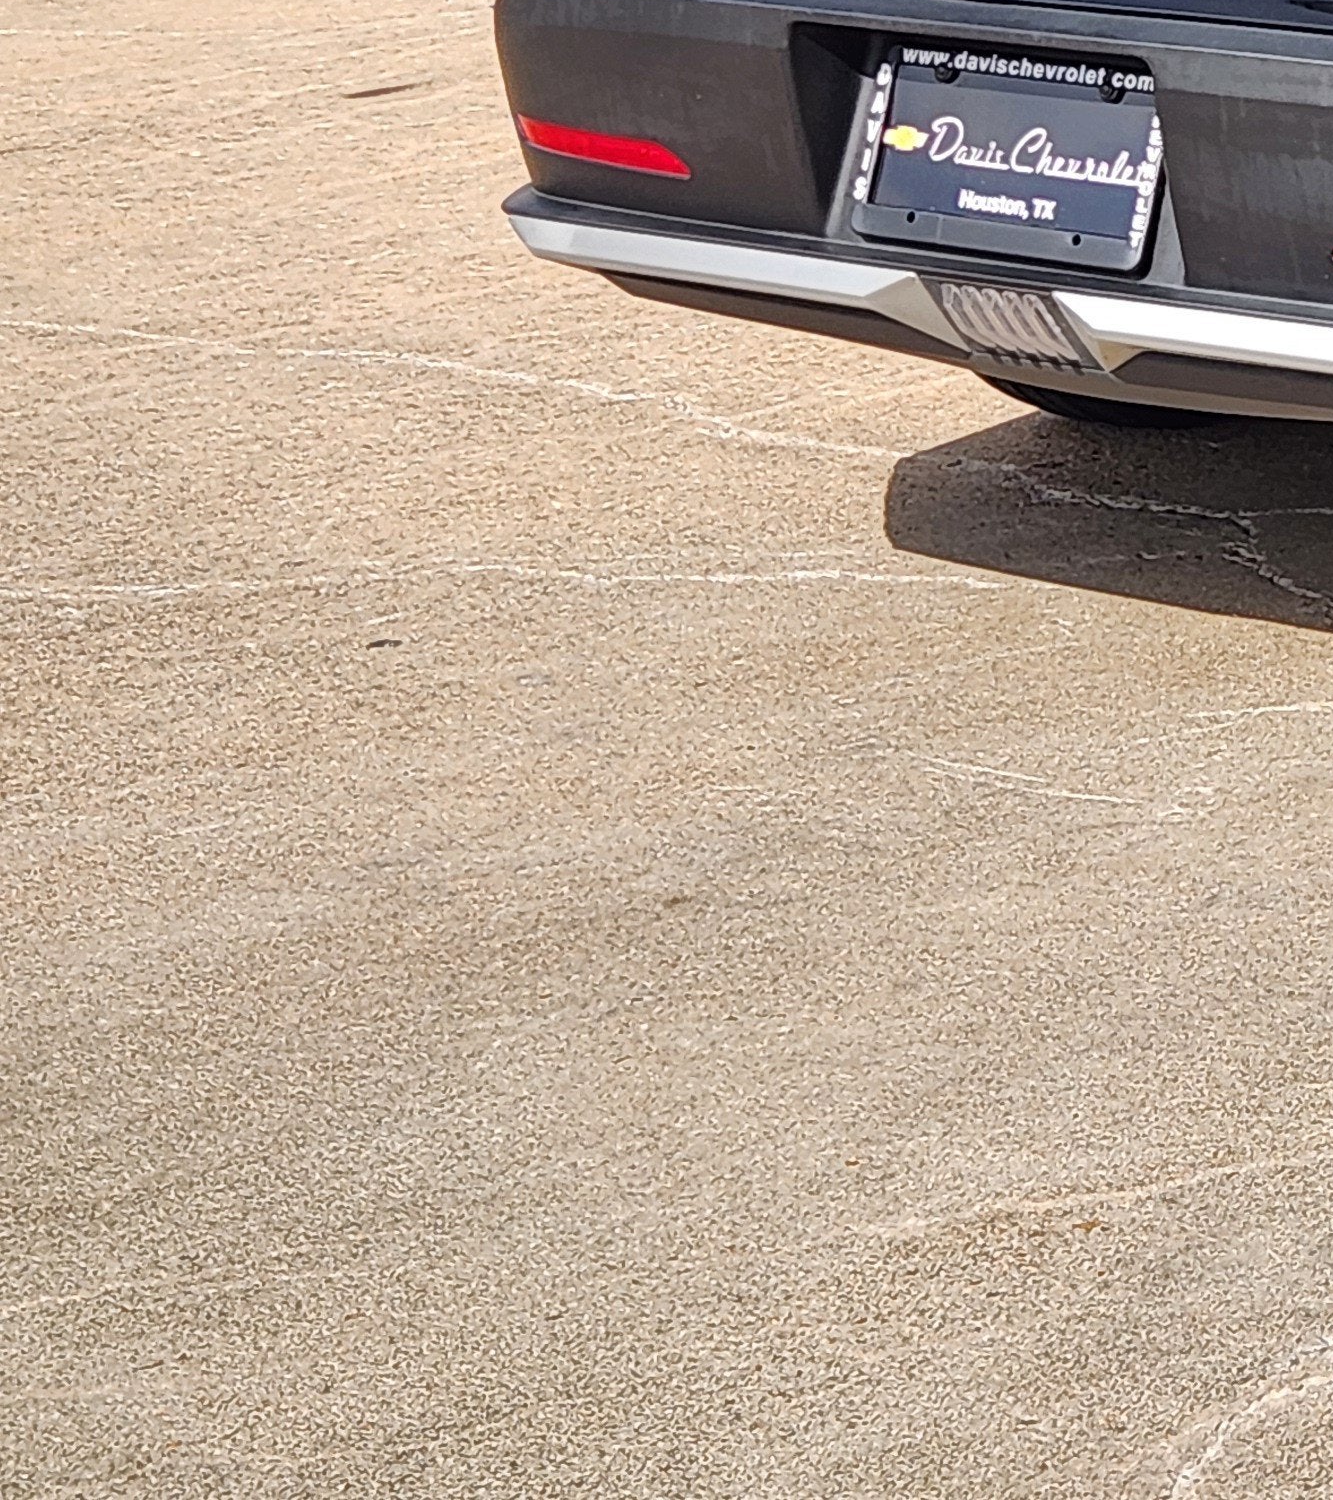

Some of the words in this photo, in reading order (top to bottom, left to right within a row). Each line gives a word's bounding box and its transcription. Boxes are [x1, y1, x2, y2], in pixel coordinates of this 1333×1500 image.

[902, 48, 1155, 92] www.davischevroletcom
[852, 62, 892, 200] DAVIS
[929, 116, 1011, 171] Davis
[1010, 127, 1148, 188] Chevrolet
[1032, 198, 1057, 221] TX
[1129, 115, 1164, 248] EVROLET
